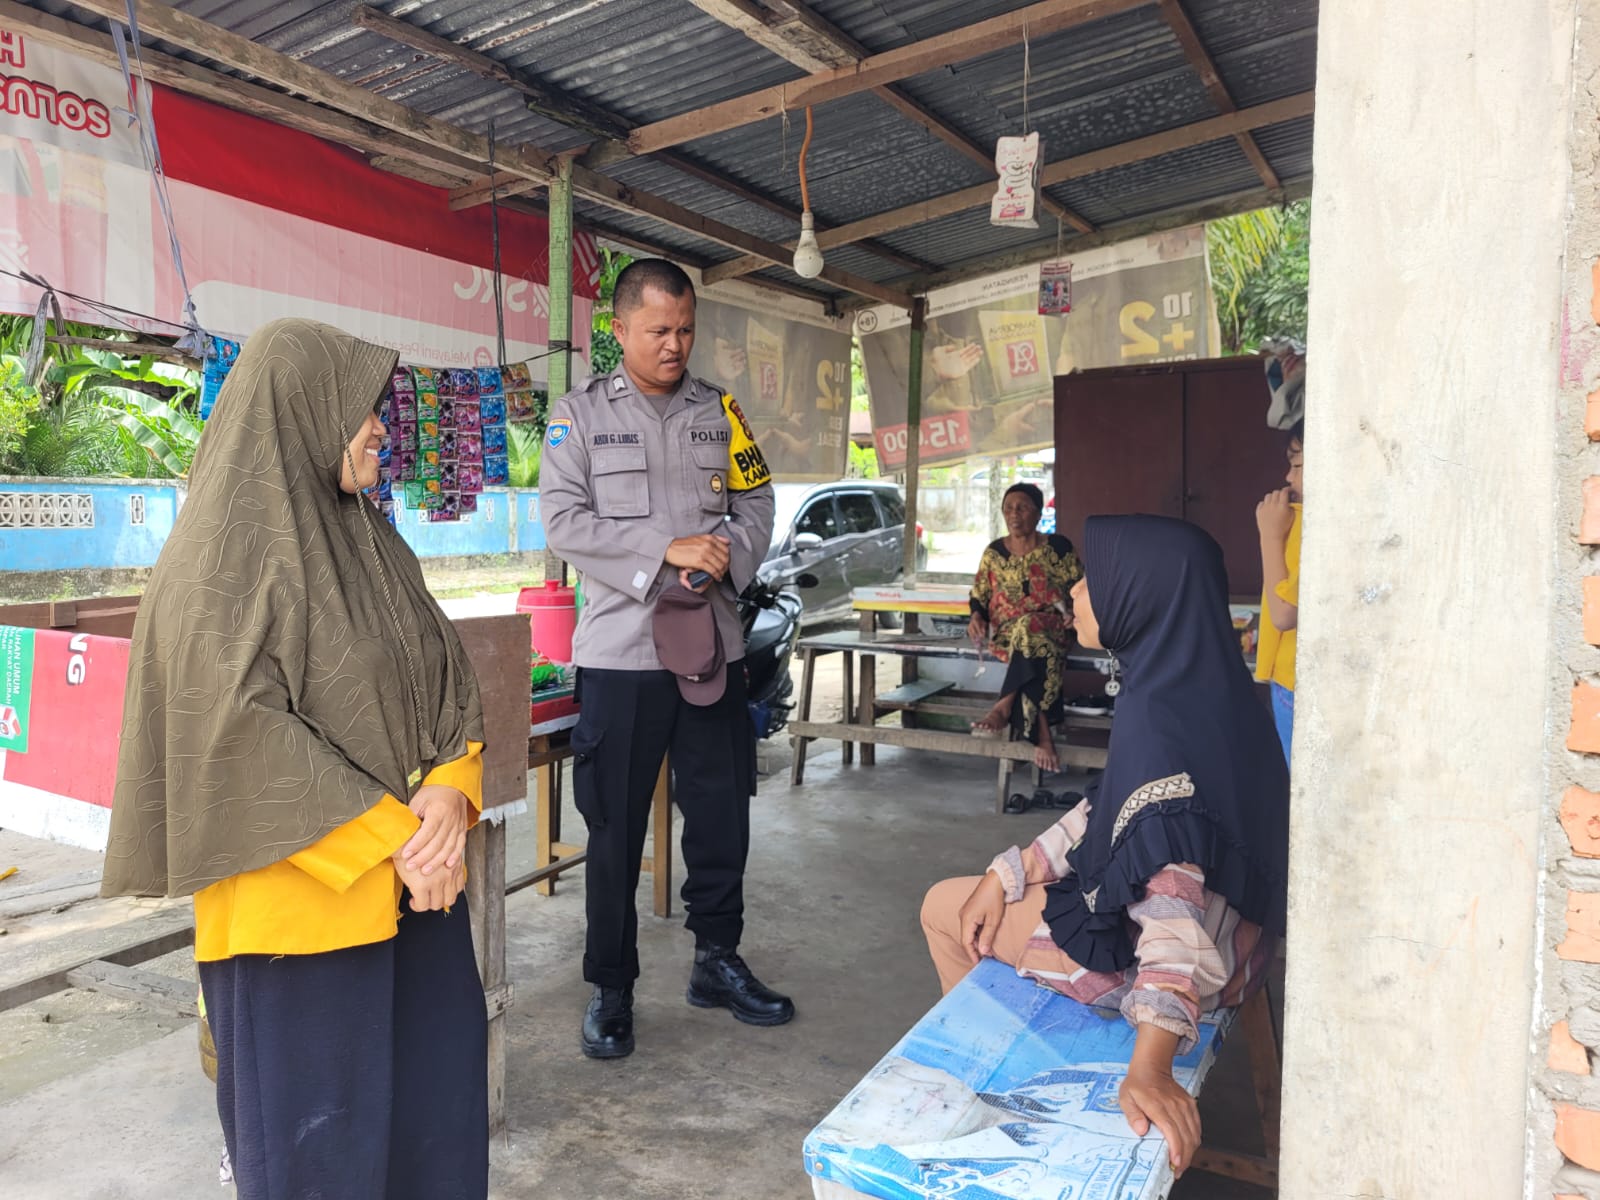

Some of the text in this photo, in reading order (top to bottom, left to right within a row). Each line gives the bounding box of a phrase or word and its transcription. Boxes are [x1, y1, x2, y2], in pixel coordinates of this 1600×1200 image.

[0, 73, 112, 139] SOLU
[690, 430, 728, 443] POLISI
[5, 672, 13, 705] DAERAH
[13, 662, 21, 694] UMUM
